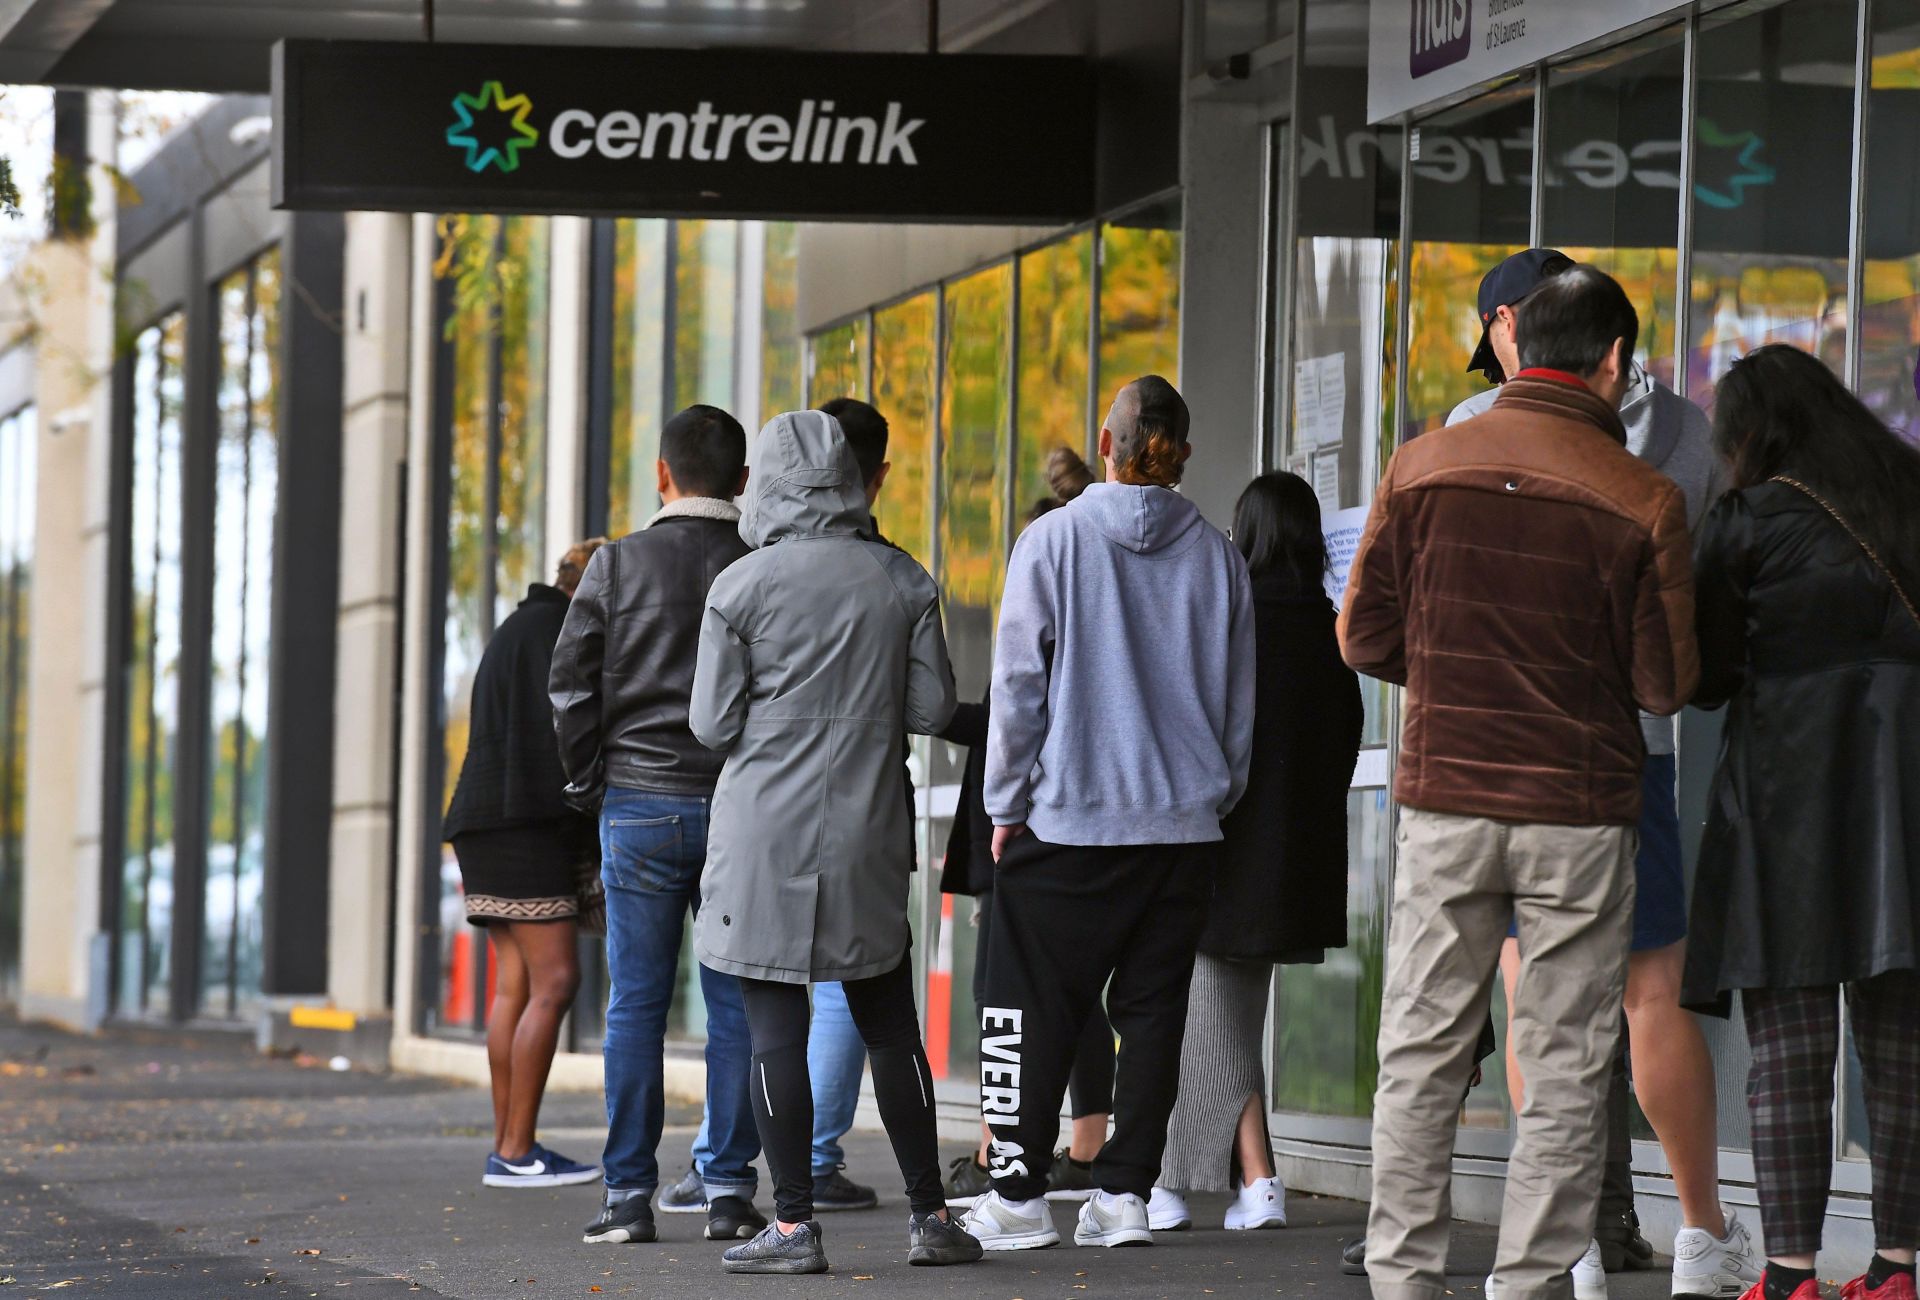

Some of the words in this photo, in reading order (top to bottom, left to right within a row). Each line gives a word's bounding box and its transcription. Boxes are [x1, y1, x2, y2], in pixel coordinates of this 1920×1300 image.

[1486, 23, 1493, 50] of
[1500, 18, 1526, 45] Laurence
[549, 99, 927, 165] centrelink
